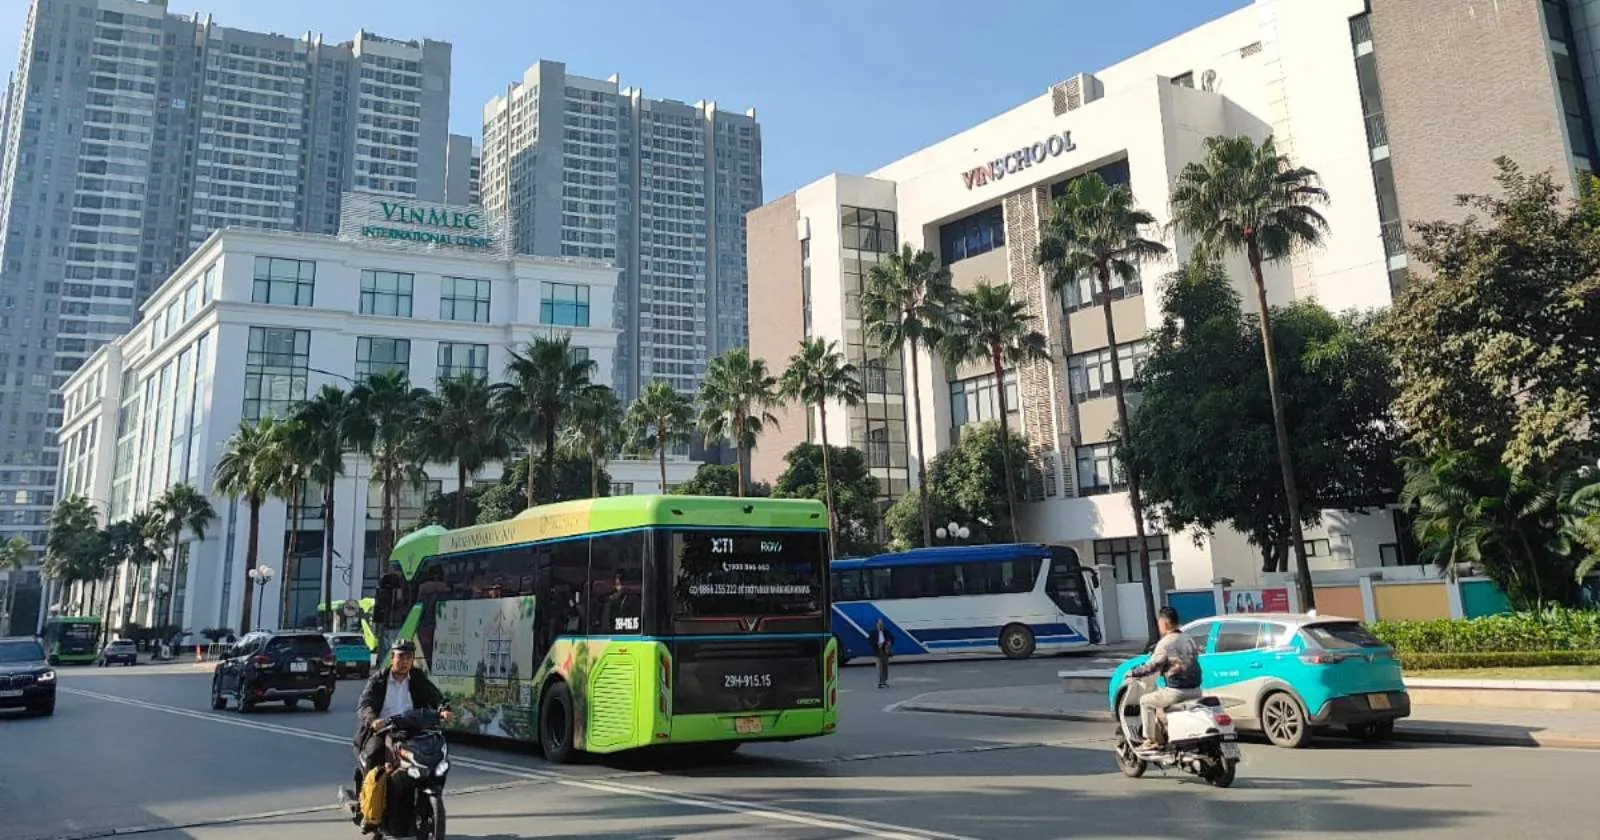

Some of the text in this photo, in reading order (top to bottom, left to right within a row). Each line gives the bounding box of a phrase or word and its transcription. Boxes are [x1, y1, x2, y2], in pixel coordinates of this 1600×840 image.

[961, 130, 1077, 191] VINSCHOOL
[378, 201, 480, 230] VINMEC
[361, 226, 454, 245] INTERNATIONAL
[724, 674, 772, 688] 29H-915.15
